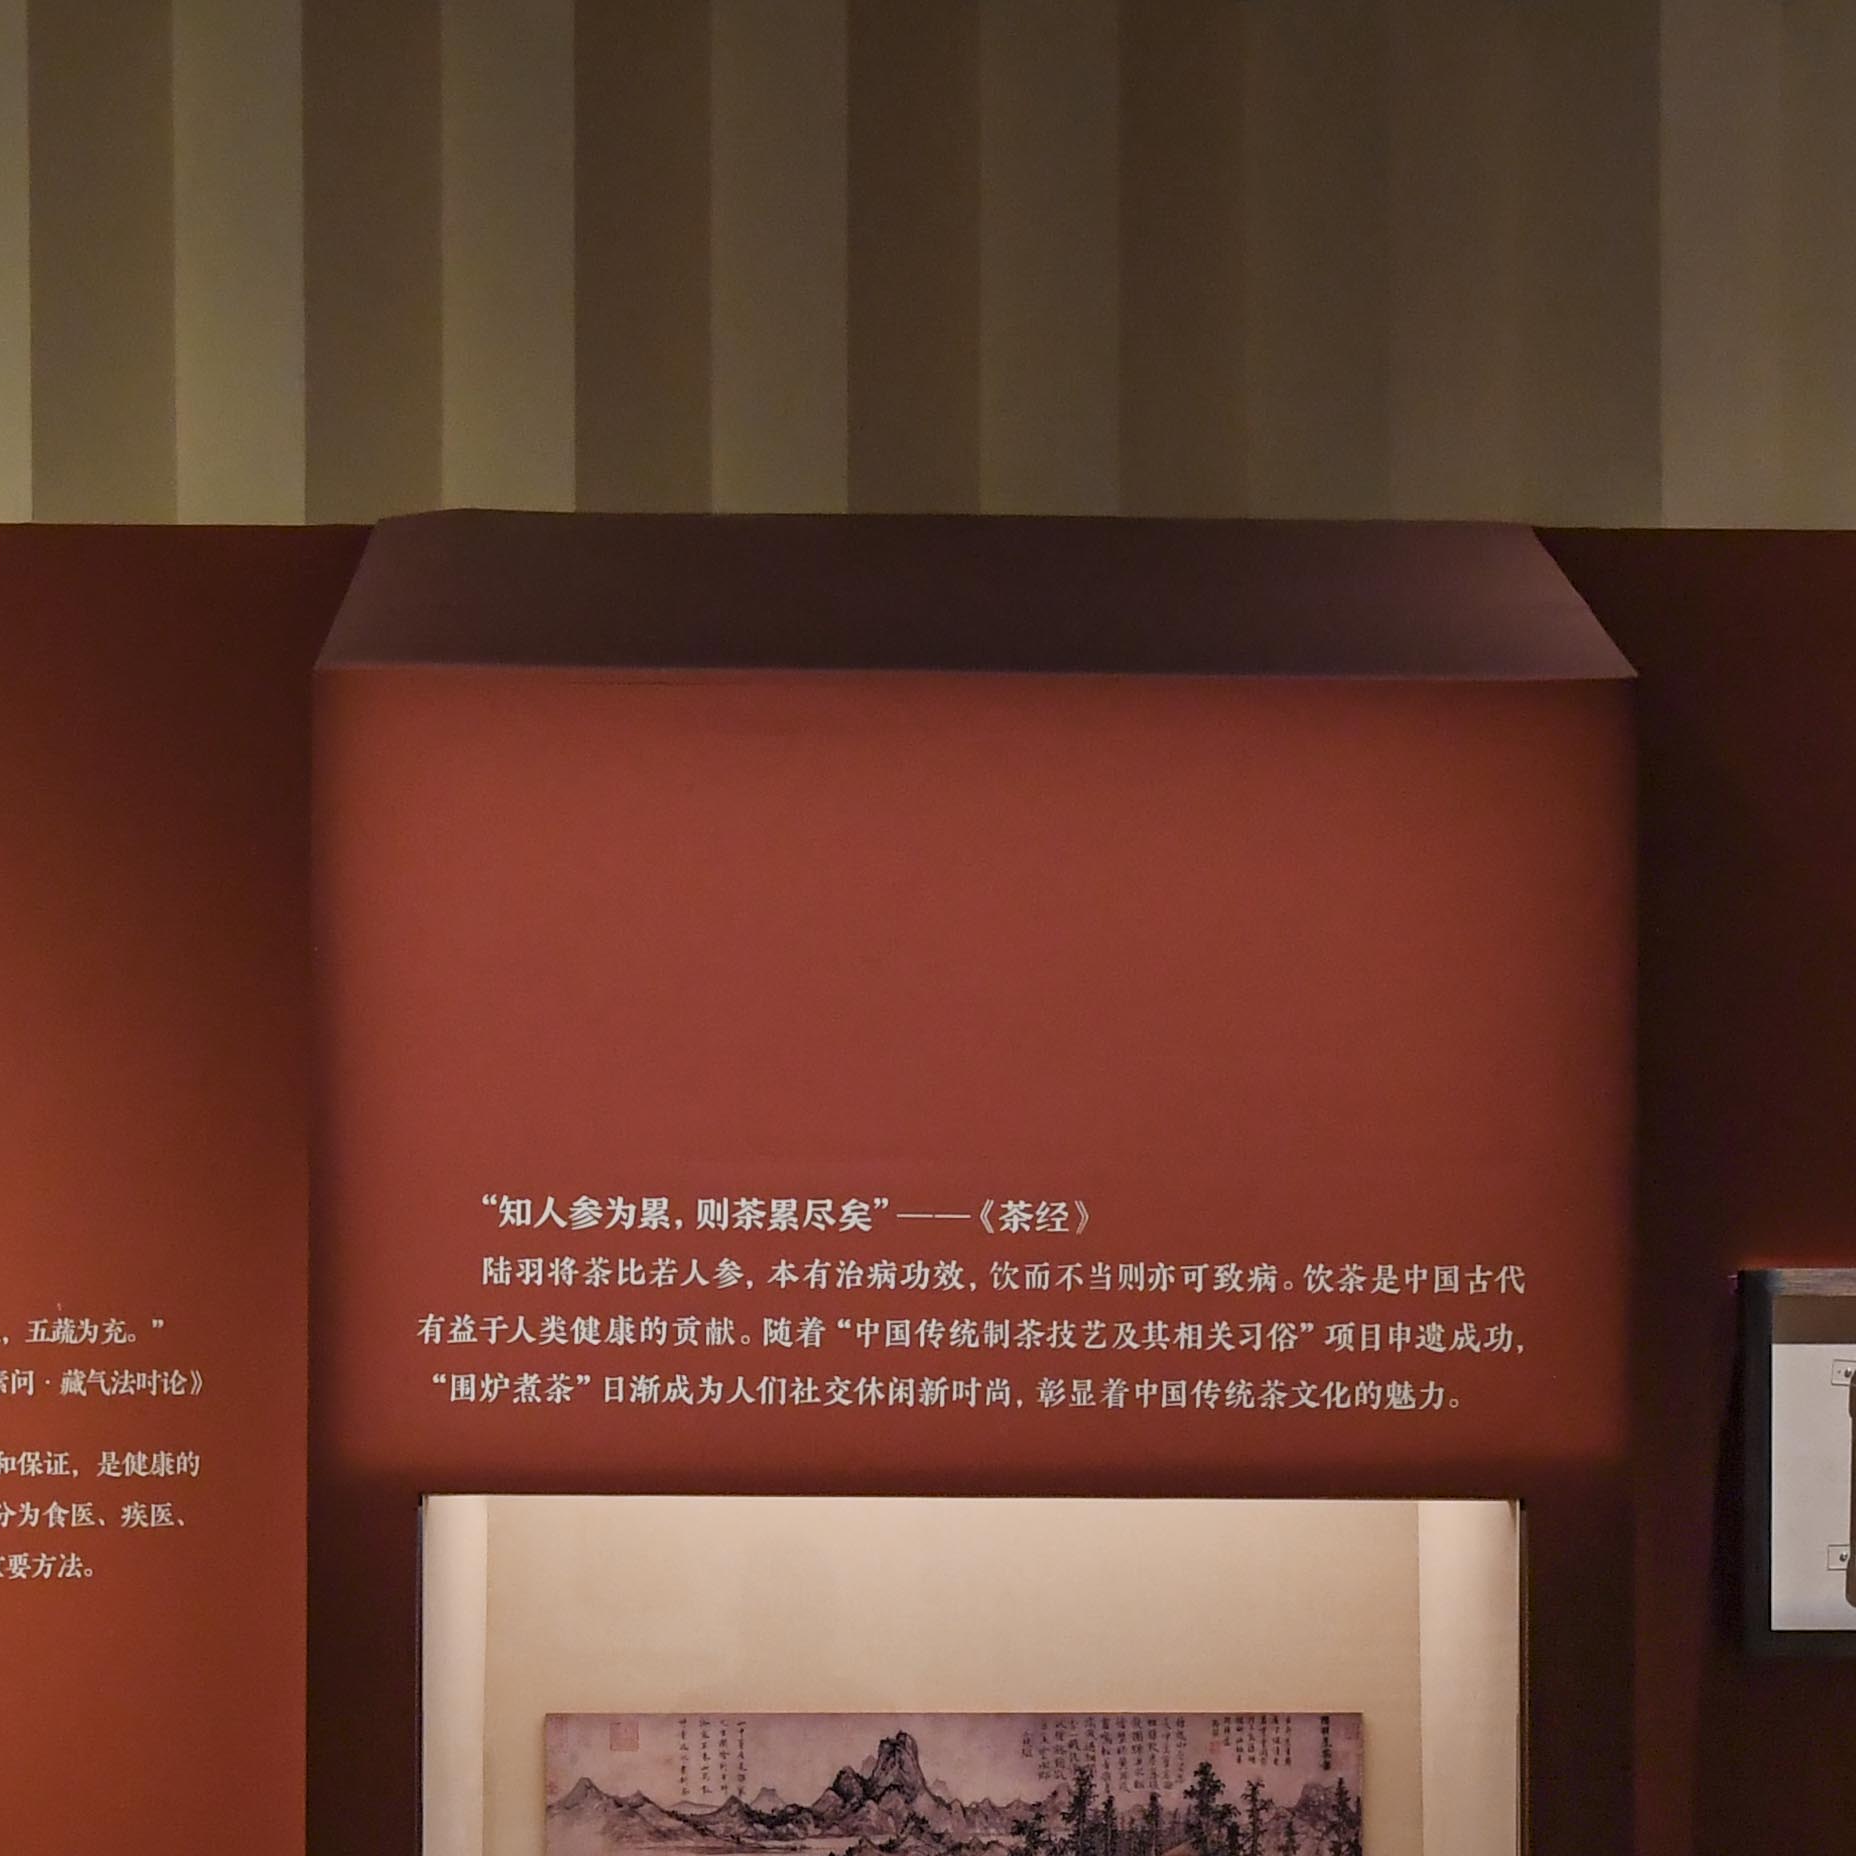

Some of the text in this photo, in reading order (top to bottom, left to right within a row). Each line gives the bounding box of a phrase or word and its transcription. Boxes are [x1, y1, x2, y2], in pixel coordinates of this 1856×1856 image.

[481, 1254, 1527, 1297] 陆羽将茶比若人参，本有治病功效，饮而不当则亦可致病。饮茶是中国古代
